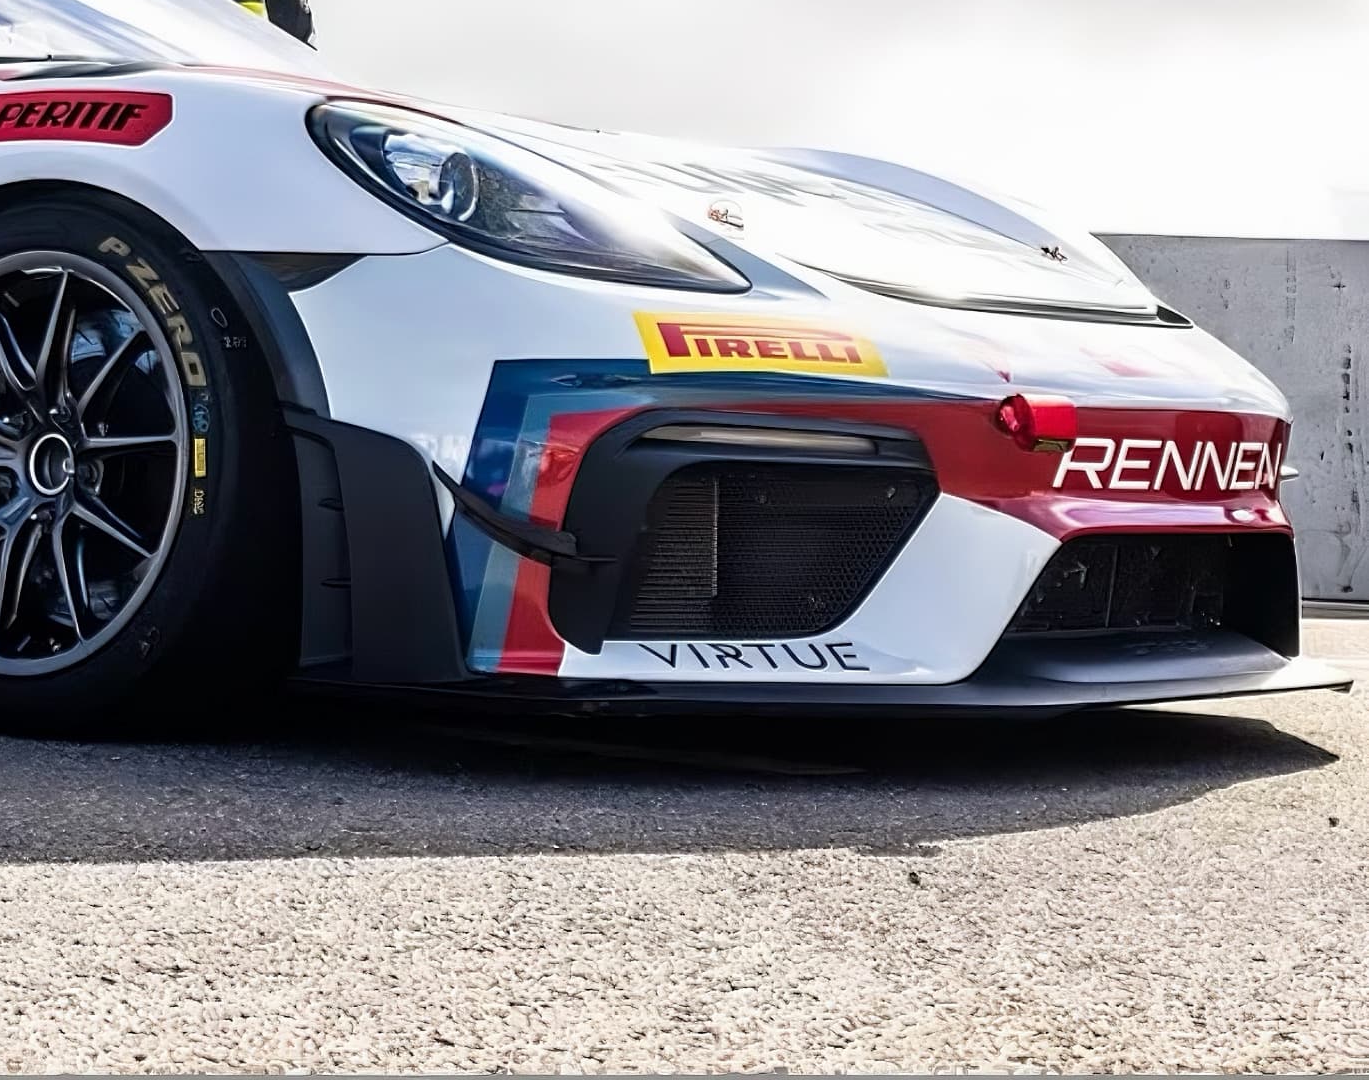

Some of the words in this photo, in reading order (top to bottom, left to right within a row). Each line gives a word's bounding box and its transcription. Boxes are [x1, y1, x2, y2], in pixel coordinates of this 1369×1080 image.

[657, 322, 863, 364] PIRELLI
[1051, 437, 1283, 492] RENNEN
[638, 642, 870, 671] VIRTUE
